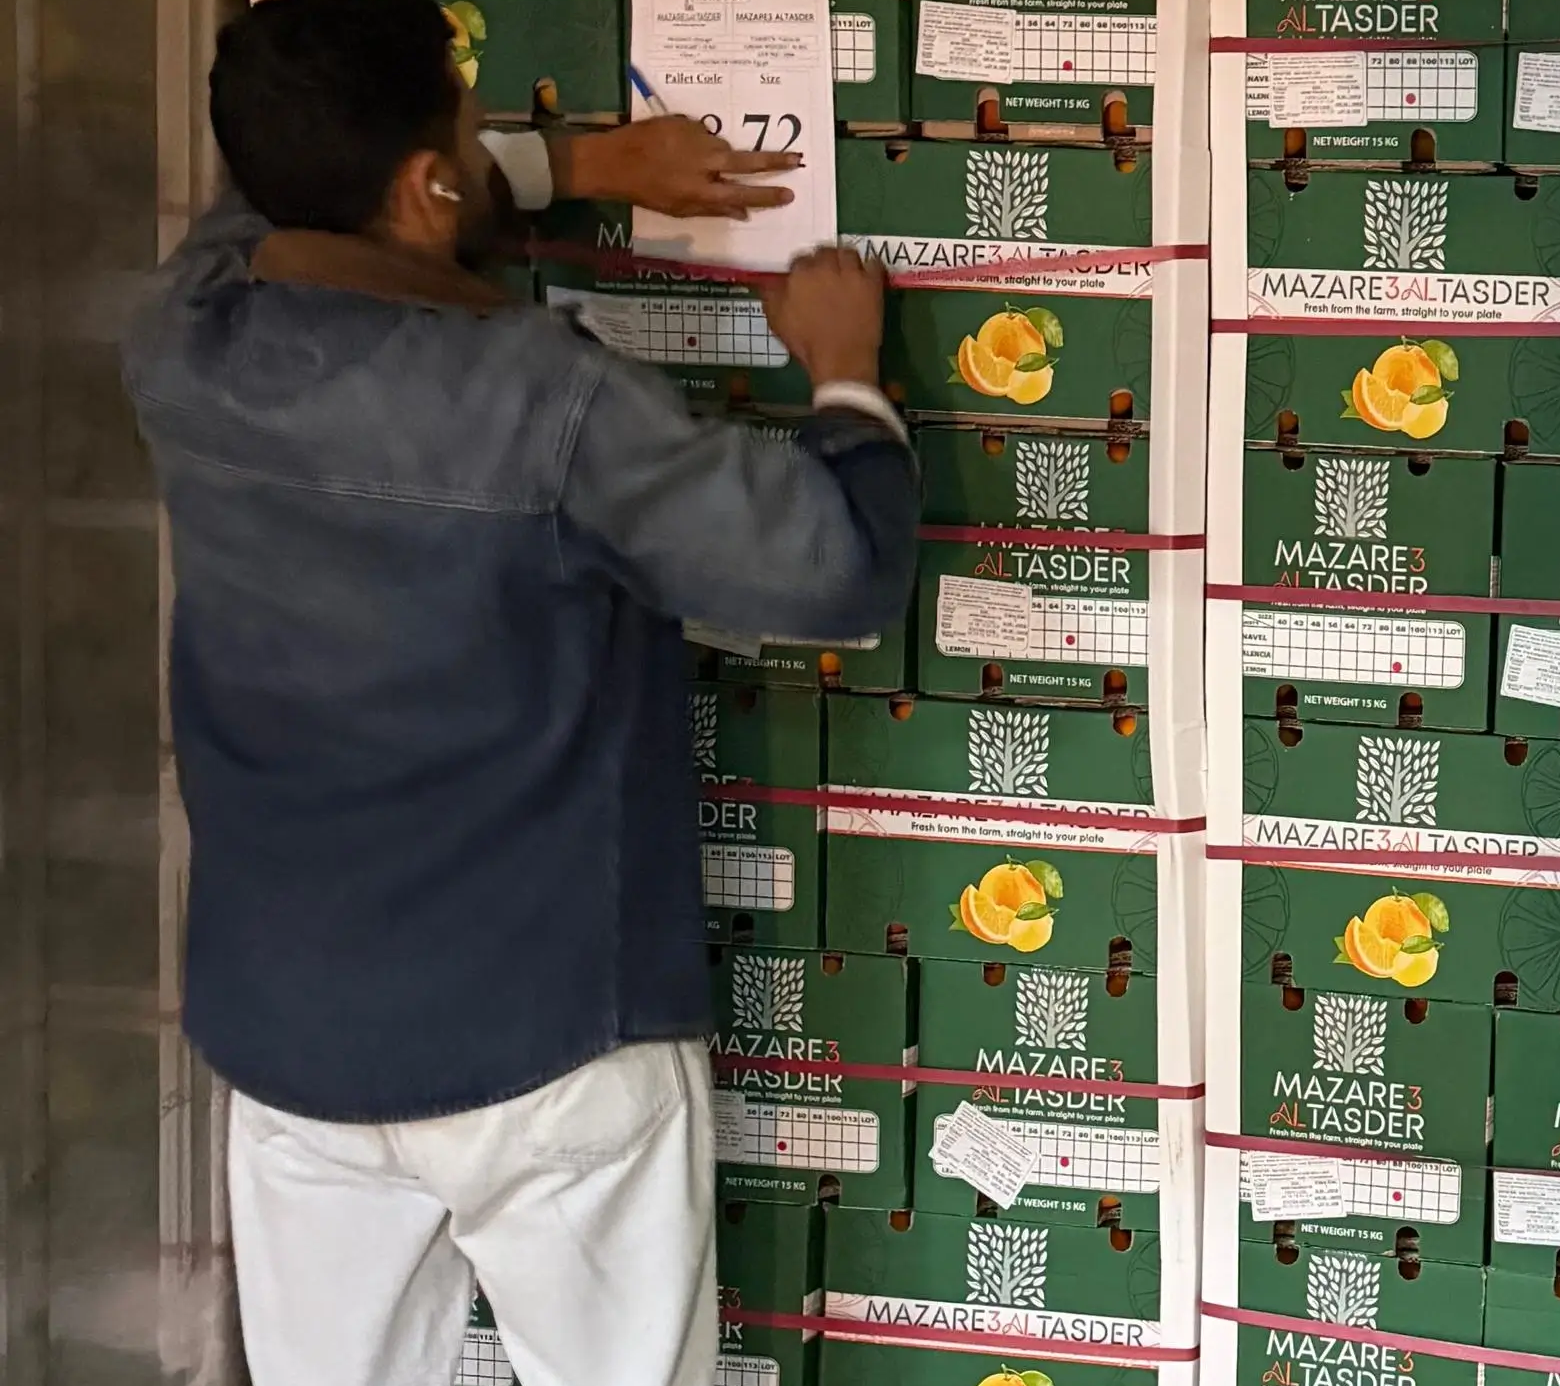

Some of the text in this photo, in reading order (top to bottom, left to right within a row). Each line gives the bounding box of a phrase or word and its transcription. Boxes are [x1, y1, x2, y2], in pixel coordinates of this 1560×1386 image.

[1276, 5, 1439, 33] ALTASDER
[665, 73, 723, 84] Pallet Code
[760, 74, 780, 84] Size
[1006, 97, 1090, 109] NET WEIGHT 15 KG
[742, 114, 804, 157] 72
[1313, 136, 1398, 147] NET WEIGHT 15 KG
[1262, 273, 1550, 307] MAZARE3ALTASDER
[974, 552, 1130, 583] ALTASDER
[1274, 540, 1426, 572] MAZARE3
[1010, 674, 1091, 687] NET WEIGHT 15 KG
[1304, 695, 1387, 708] NET WEIGHT 15 KG
[976, 1048, 1123, 1082] MAZARE3
[1273, 1071, 1422, 1110] MAZARE3
[1270, 1102, 1425, 1140] ALTASDER
[1266, 1330, 1414, 1373] MAZARE3
